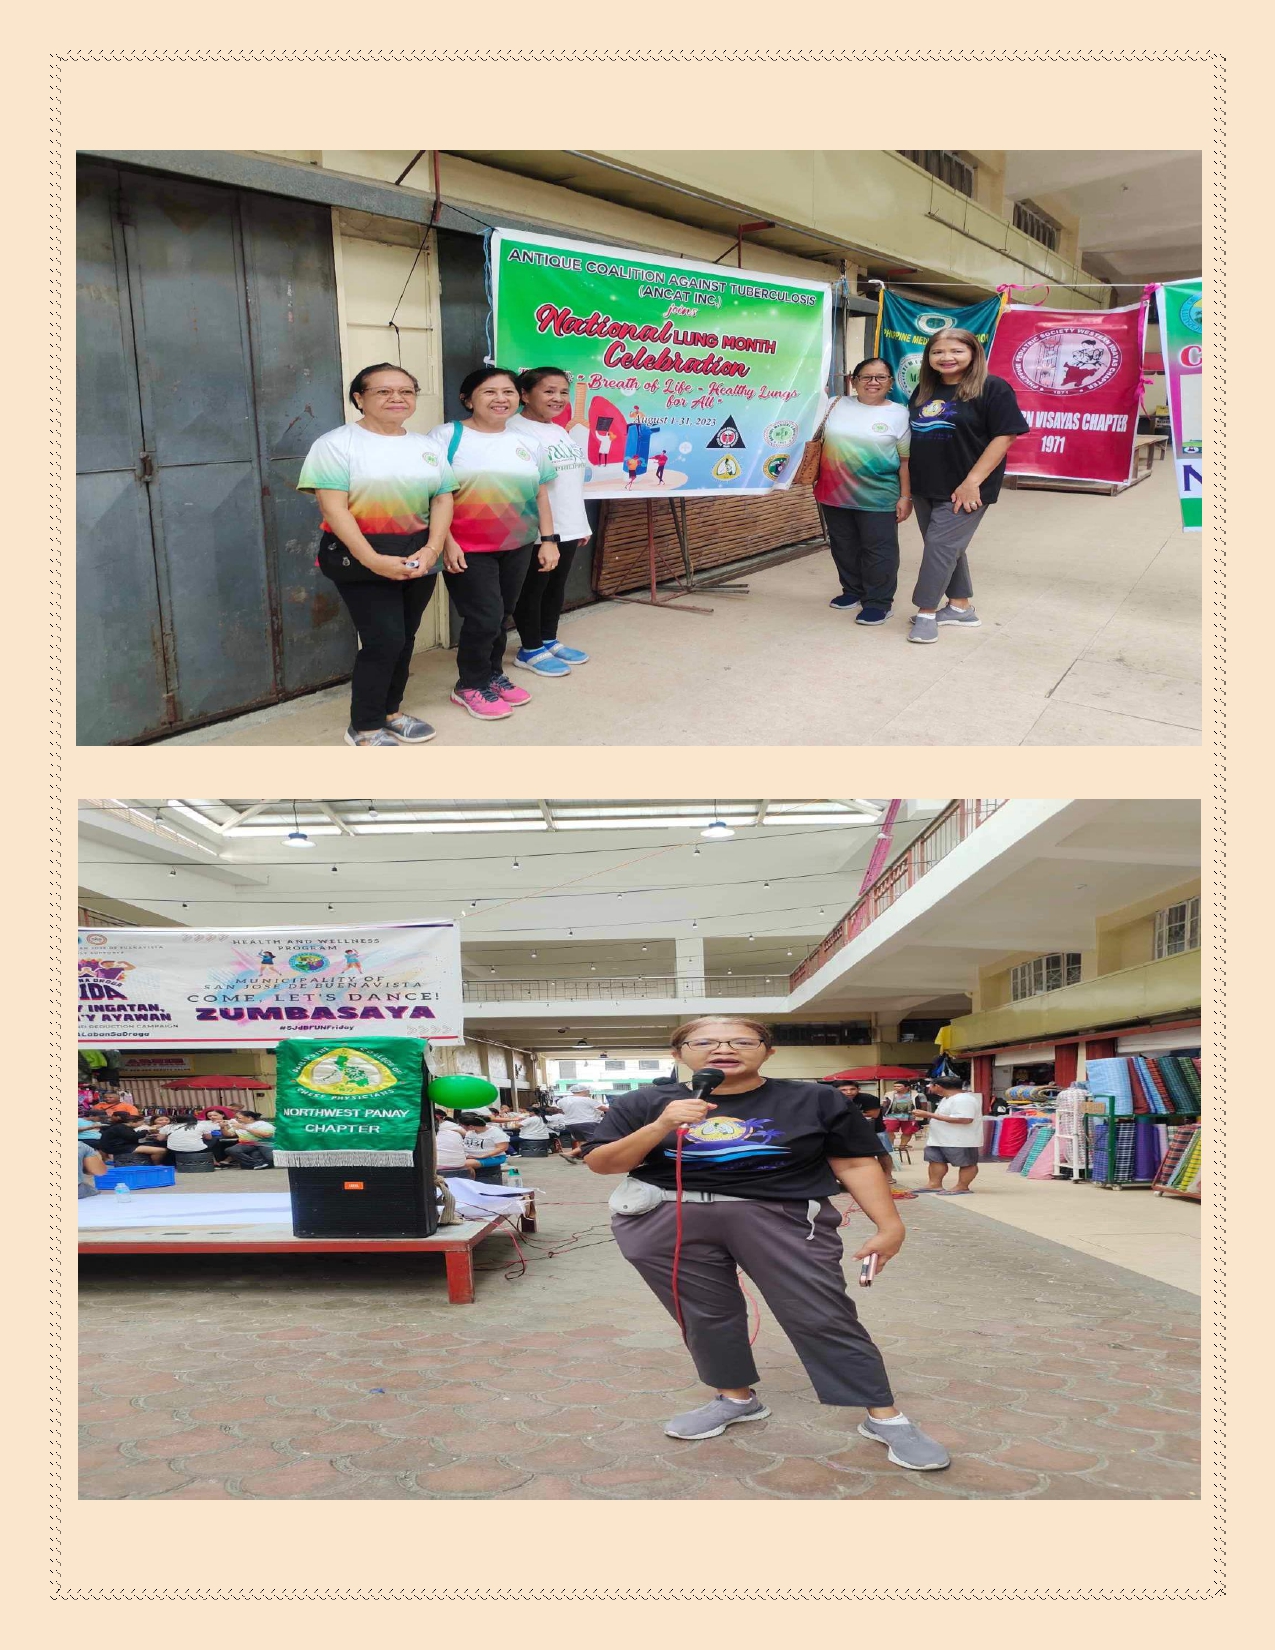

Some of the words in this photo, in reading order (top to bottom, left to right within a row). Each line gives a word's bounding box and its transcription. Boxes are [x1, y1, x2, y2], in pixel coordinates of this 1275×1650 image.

[508, 249, 582, 271] ANTIQUE
[586, 261, 665, 283] COALITION
[668, 275, 726, 292] AGAINST
[730, 284, 816, 306] TUBERCULOSIS
[639, 286, 690, 302] (ANCAT
[694, 294, 722, 308] INC.)
[663, 303, 698, 318] joins
[534, 303, 673, 343] National
[673, 330, 719, 348] LUNG
[721, 335, 777, 354] MONTH
[1039, 328, 1075, 340] SOCIETY
[602, 340, 751, 378] Celebration
[643, 378, 660, 393] of
[663, 378, 693, 395] Life
[708, 381, 756, 400] Healthy
[758, 385, 800, 402] Lungs
[666, 394, 688, 410] for
[633, 415, 668, 428] August
[695, 417, 717, 427] 2023
[1035, 411, 1081, 430] VISAYAS
[1081, 413, 1129, 432] CHAPTER
[1041, 435, 1066, 453] 1971
[235, 976, 356, 984] MUNICIPALITY
[79, 983, 129, 1000] IDA
[187, 994, 262, 1003] COME,
[275, 994, 336, 1002] LET'S
[349, 992, 440, 1001] DANCE!
[88, 1004, 165, 1013] INGATAN,
[195, 1006, 436, 1021] ZUMBASAYA
[102, 1013, 172, 1021] AYAWAN
[283, 1108, 360, 1118] NORTHWEST
[364, 1109, 410, 1118] PANAY
[305, 1124, 380, 1134] CHAPTER
